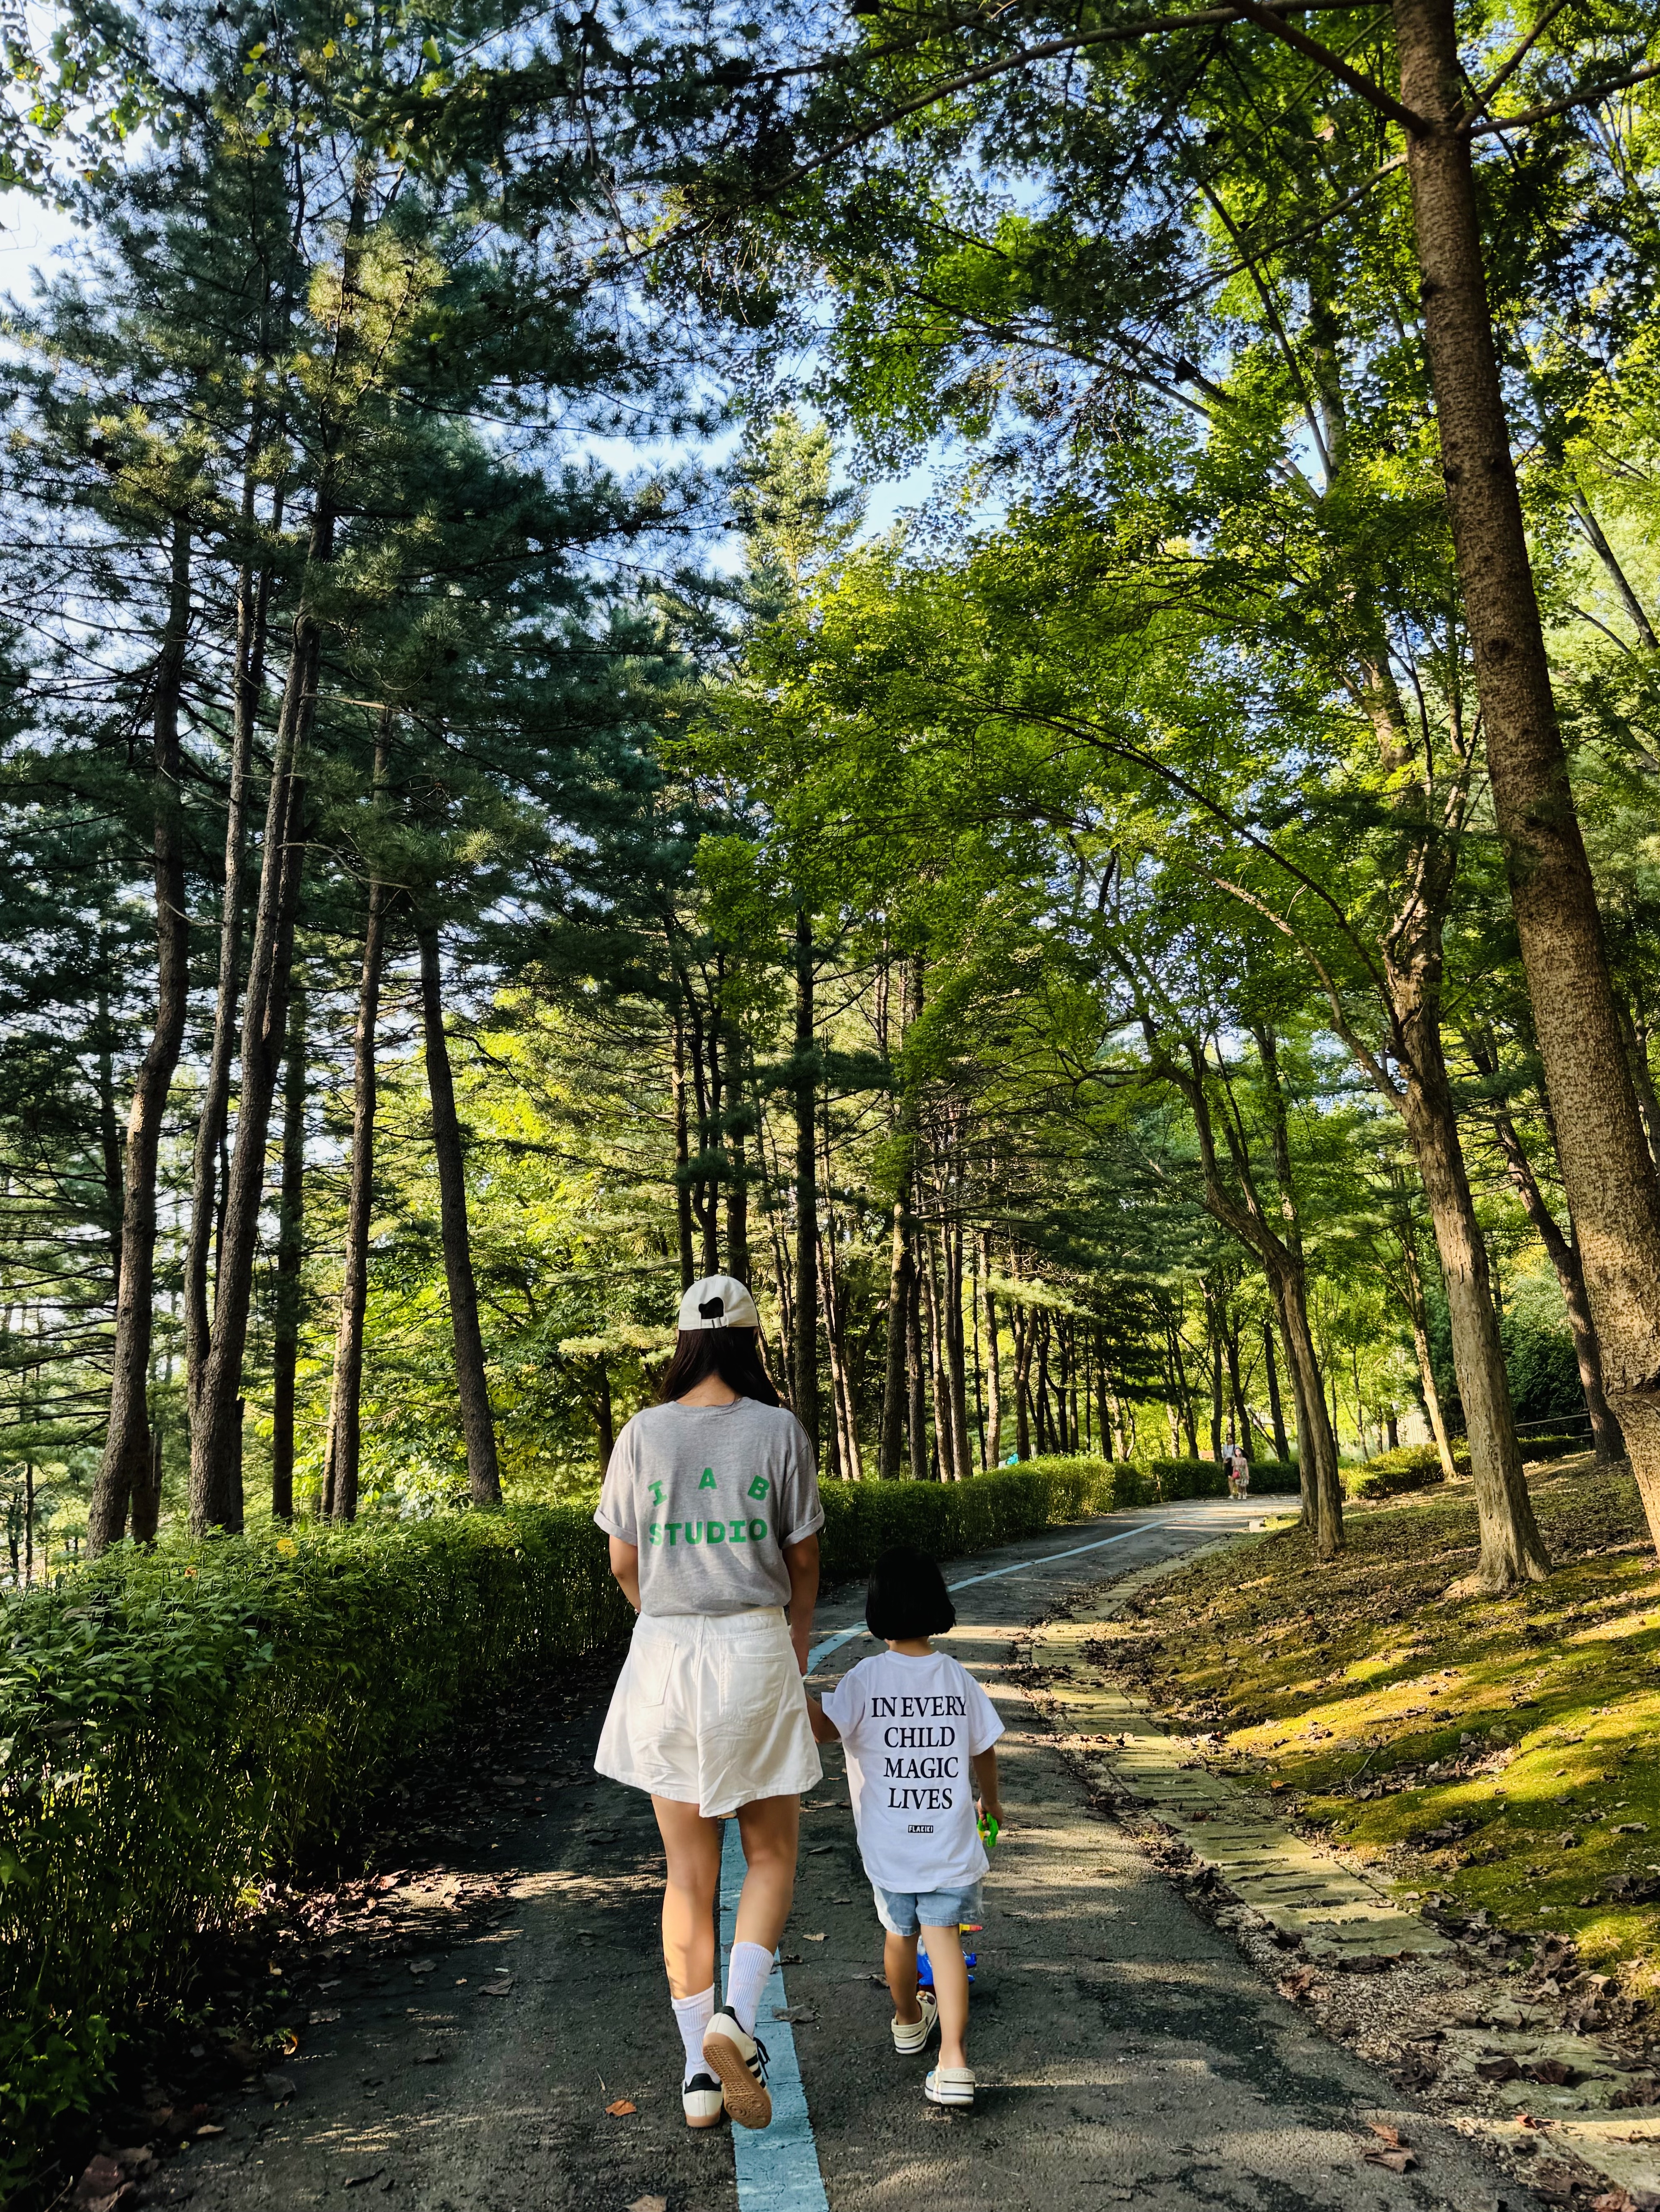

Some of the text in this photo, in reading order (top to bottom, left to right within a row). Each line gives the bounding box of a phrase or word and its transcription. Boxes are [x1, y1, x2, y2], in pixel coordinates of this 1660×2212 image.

[649, 1518, 768, 1546] STUDIO
[871, 1696, 967, 1718] IN EVERY
[884, 1726, 955, 1748] CHILD
[883, 1757, 959, 1778] MAGIC
[887, 1787, 953, 1809] LIVES
